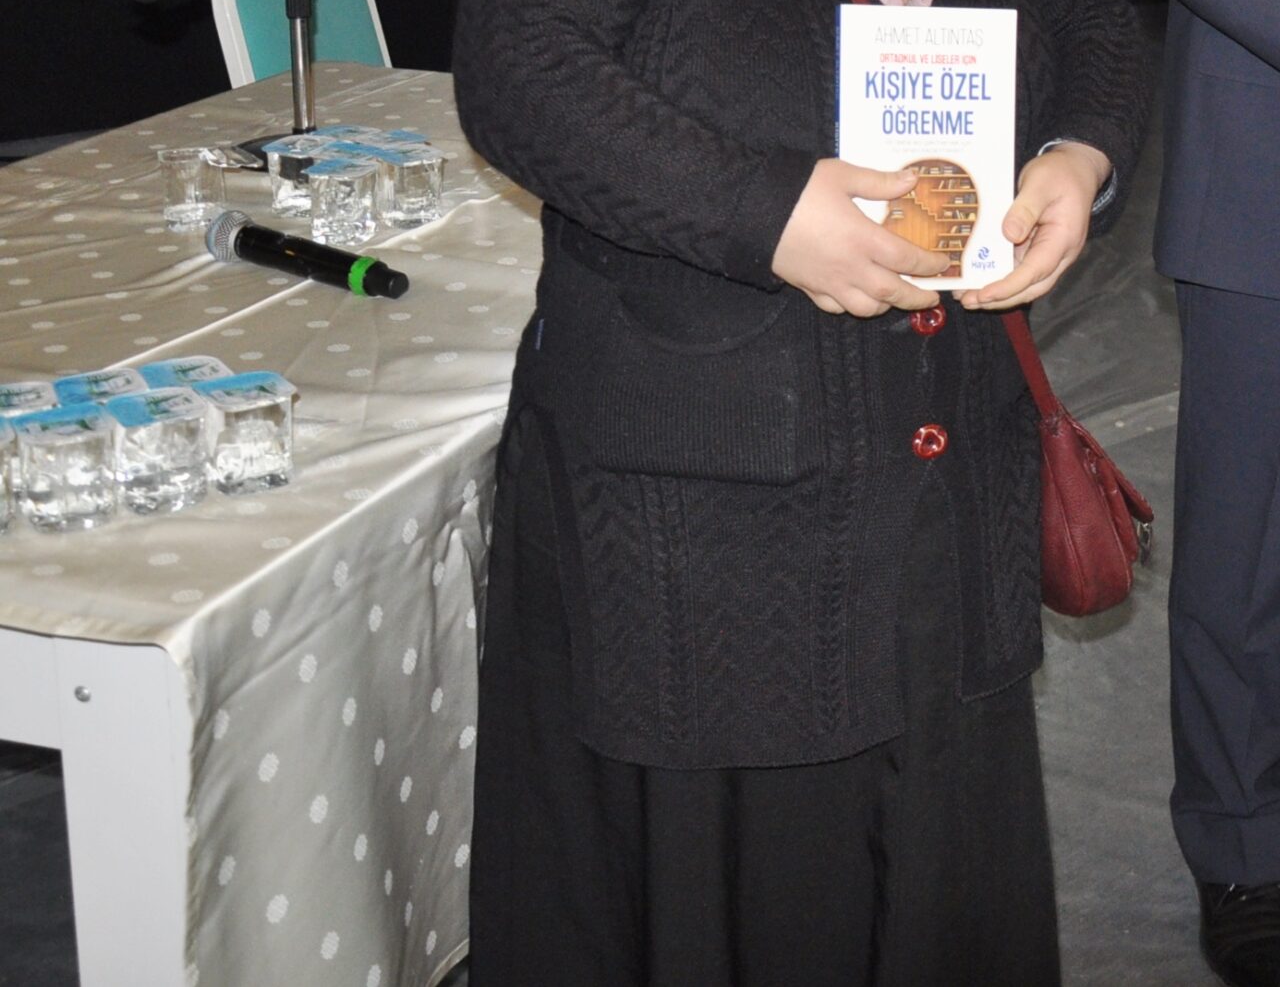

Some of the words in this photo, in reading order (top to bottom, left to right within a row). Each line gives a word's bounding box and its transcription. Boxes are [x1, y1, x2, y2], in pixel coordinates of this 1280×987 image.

[875, 26, 920, 45] AHMET
[925, 28, 984, 48] ALTINTAŞ
[865, 66, 933, 101] KİŞİYE
[941, 67, 991, 100] ÖZEL
[882, 105, 974, 135] ÖĞRENME
